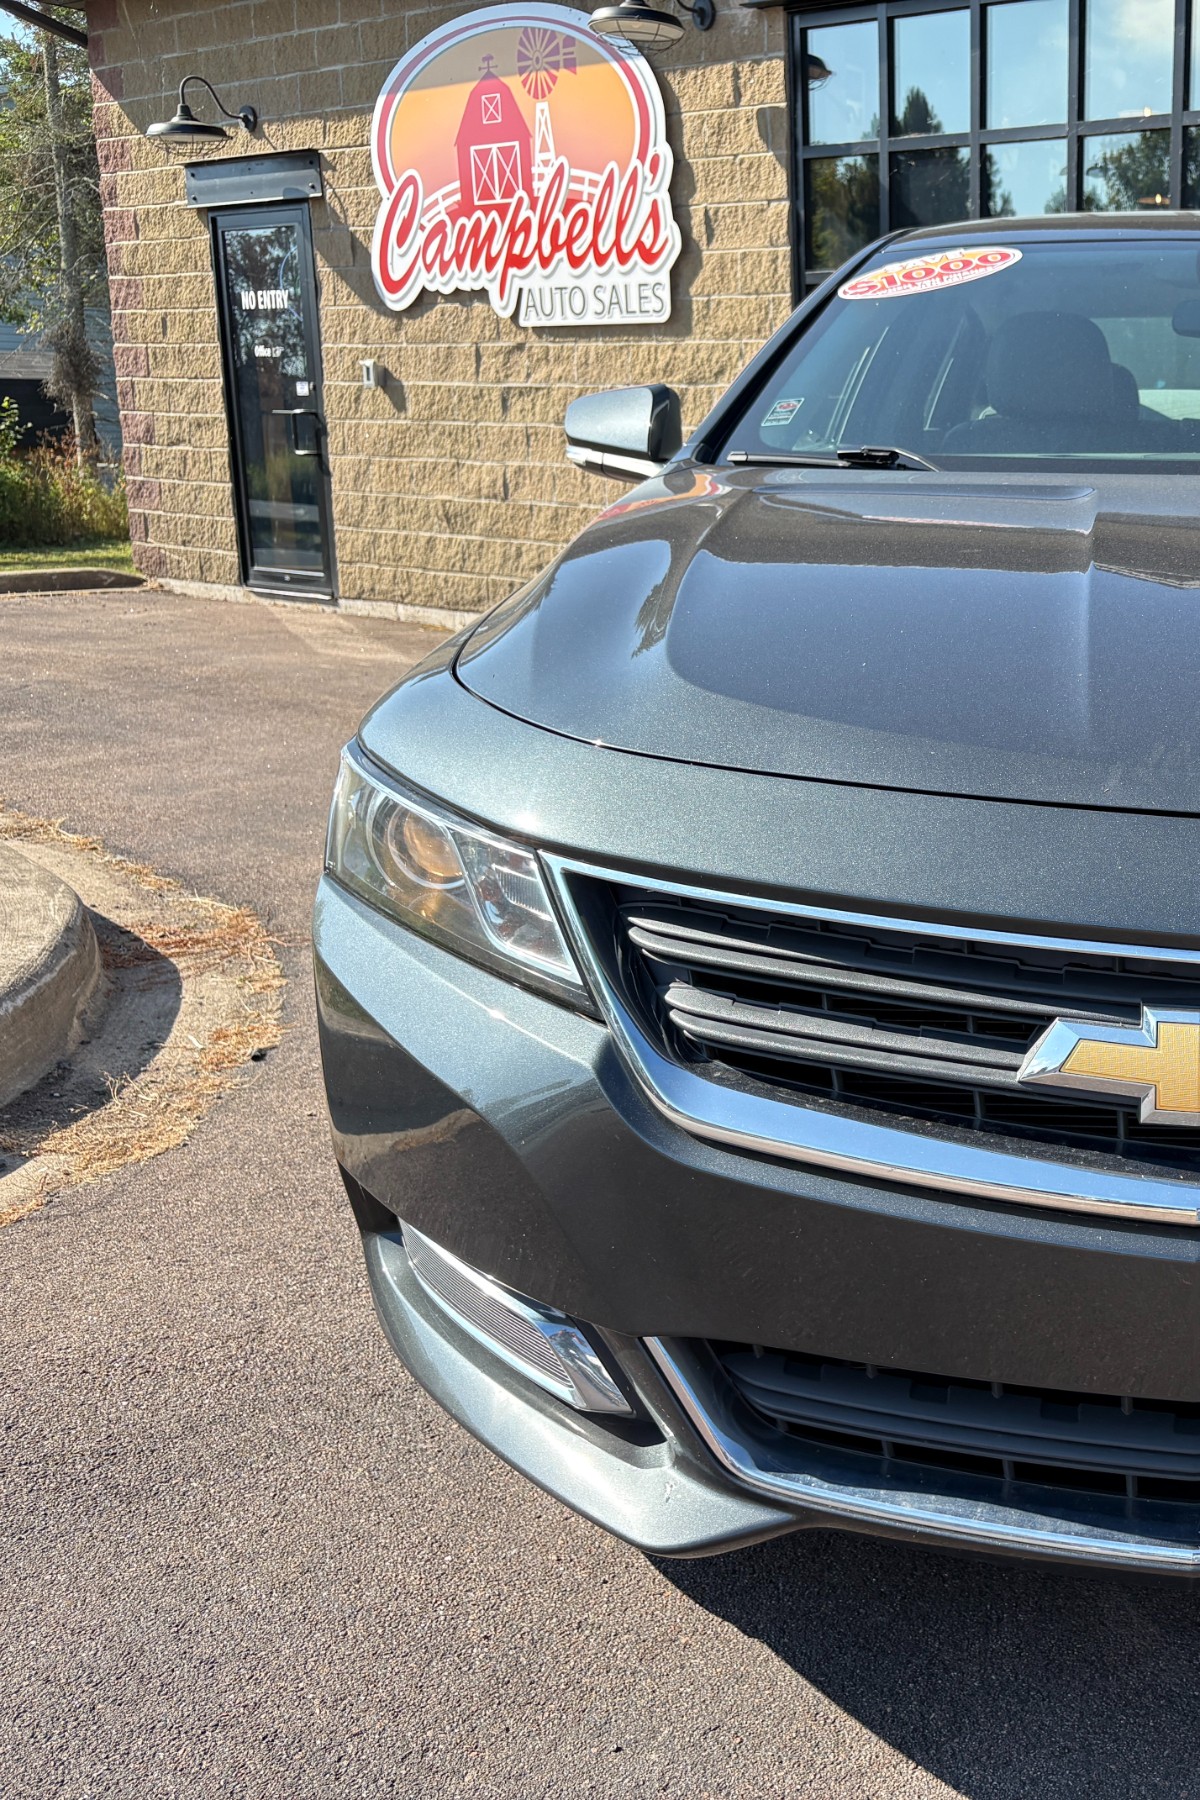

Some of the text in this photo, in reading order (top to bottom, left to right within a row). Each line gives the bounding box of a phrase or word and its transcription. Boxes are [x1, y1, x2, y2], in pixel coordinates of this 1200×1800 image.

[379, 152, 669, 301] Campbell's
[842, 251, 1014, 297] $1000
[883, 248, 965, 273] SAVE
[241, 289, 289, 310] NO ENTRY
[524, 281, 664, 320] AUTO SALES
